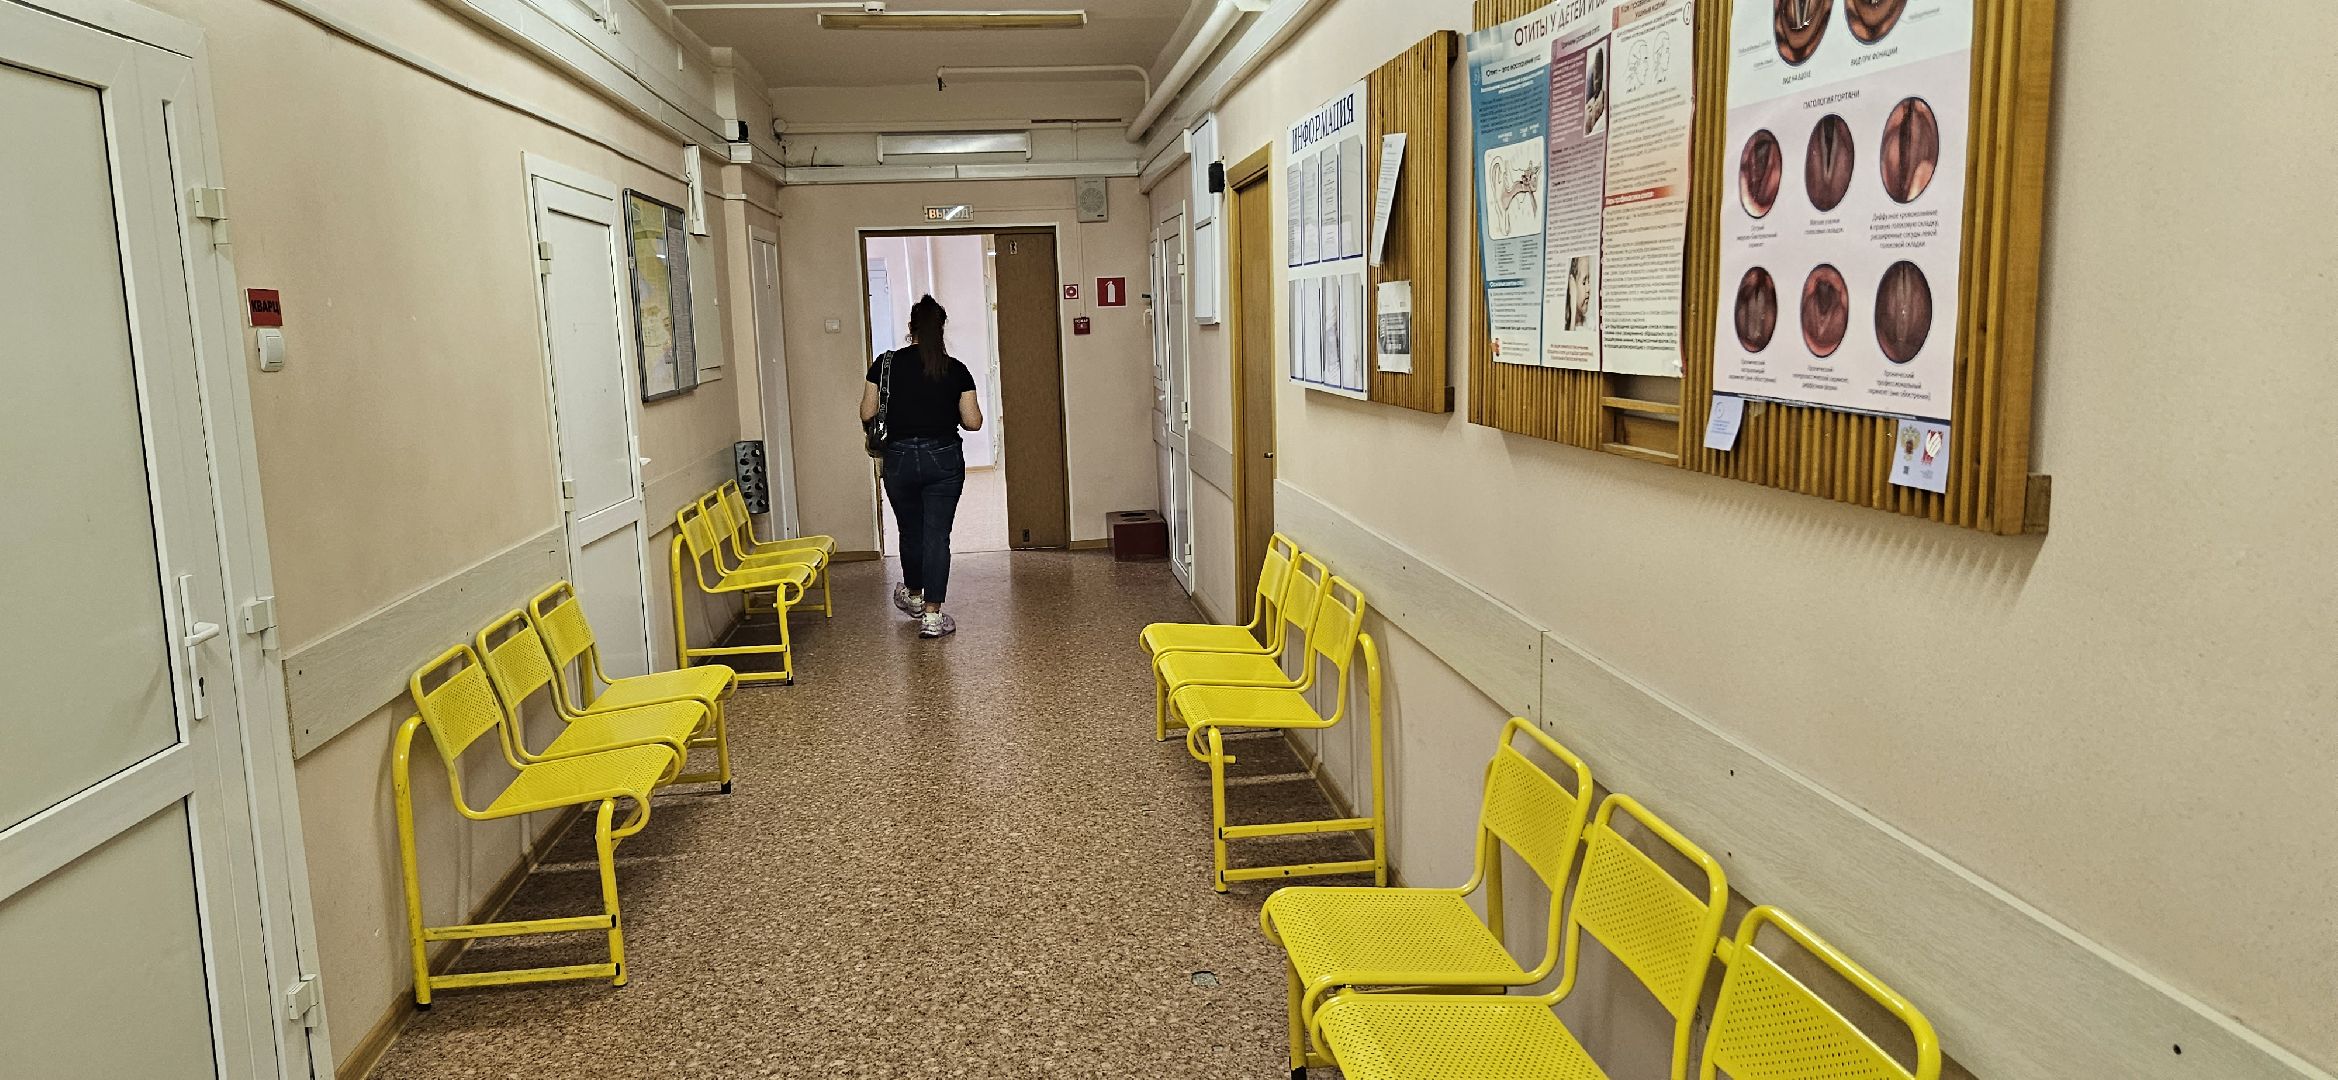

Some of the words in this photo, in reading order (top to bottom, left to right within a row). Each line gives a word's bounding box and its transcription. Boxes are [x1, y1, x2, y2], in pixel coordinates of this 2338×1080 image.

[1514, 15, 1548, 46] ОТИТЫ
[1550, 11, 1557, 32] У
[1292, 93, 1355, 154] ИНФОРМАЦИЯ
[251, 300, 280, 315] КВАРЦ
